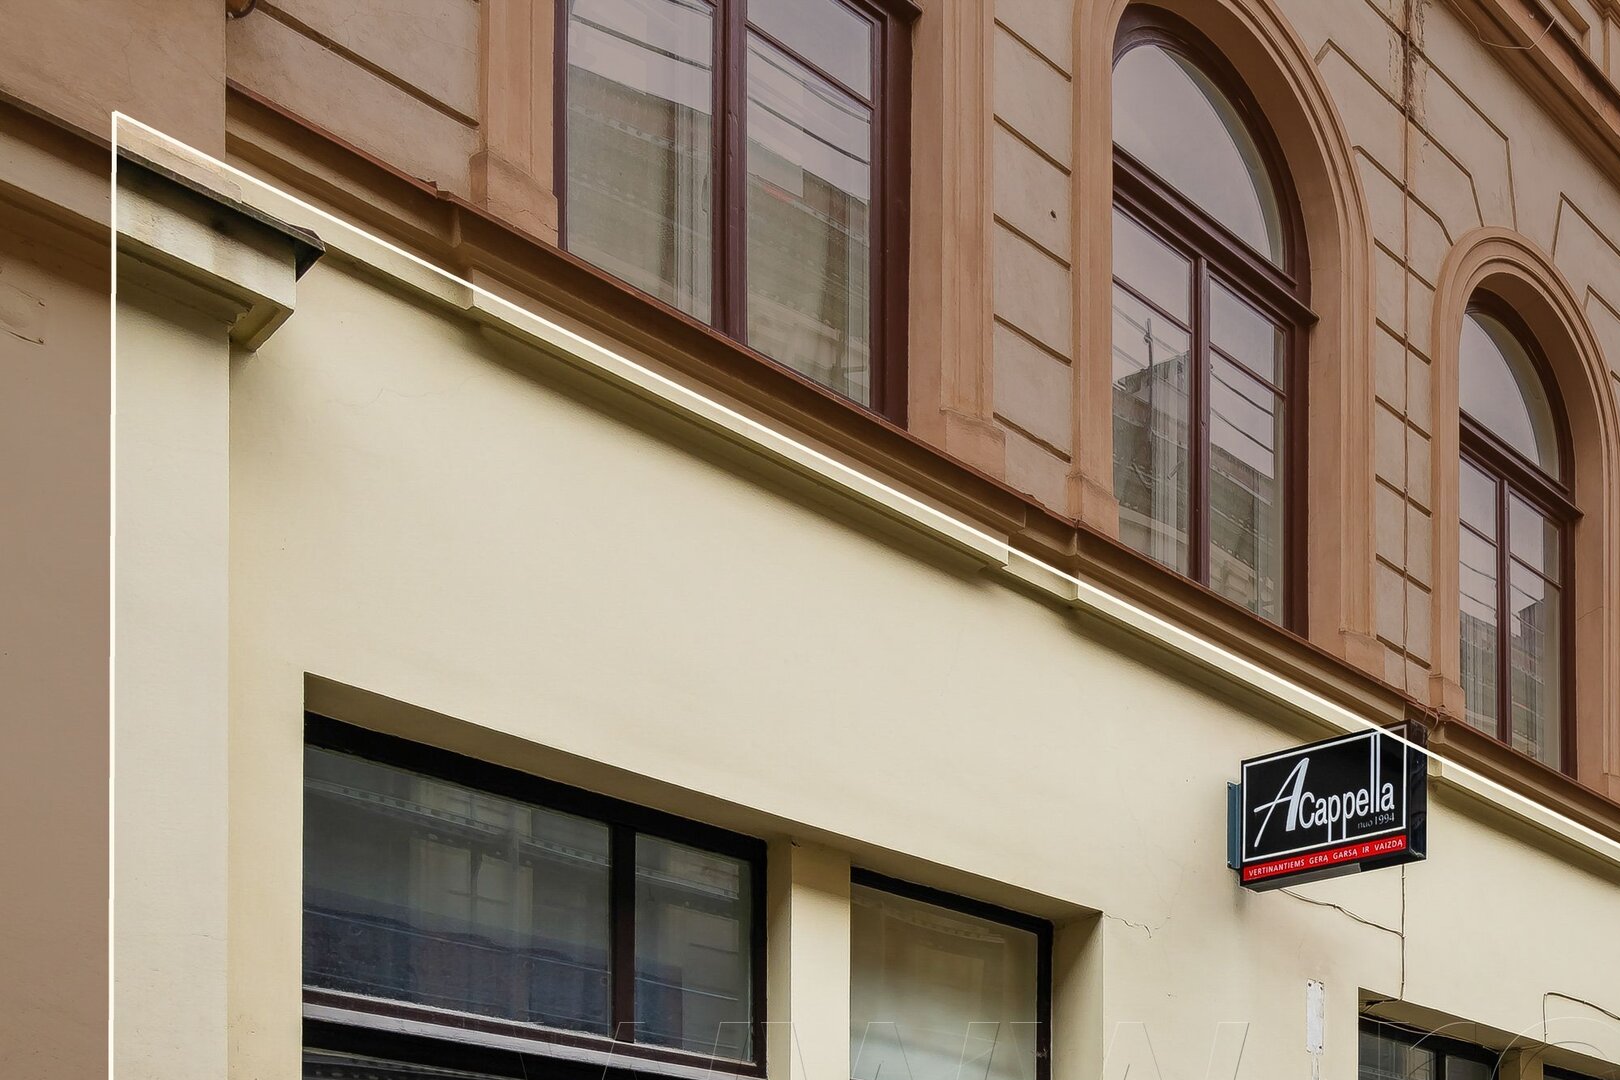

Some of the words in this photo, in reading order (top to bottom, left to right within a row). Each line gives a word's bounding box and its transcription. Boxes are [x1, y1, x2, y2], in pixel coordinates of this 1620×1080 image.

[1375, 812, 1395, 826] 1994
[1248, 858, 1305, 877] VERTINANTIEMS
[1309, 854, 1329, 865] GERĄ
[1333, 849, 1358, 860] GARSĄ
[1362, 846, 1370, 854] IR
[1374, 839, 1403, 851] VAIZDĄ
